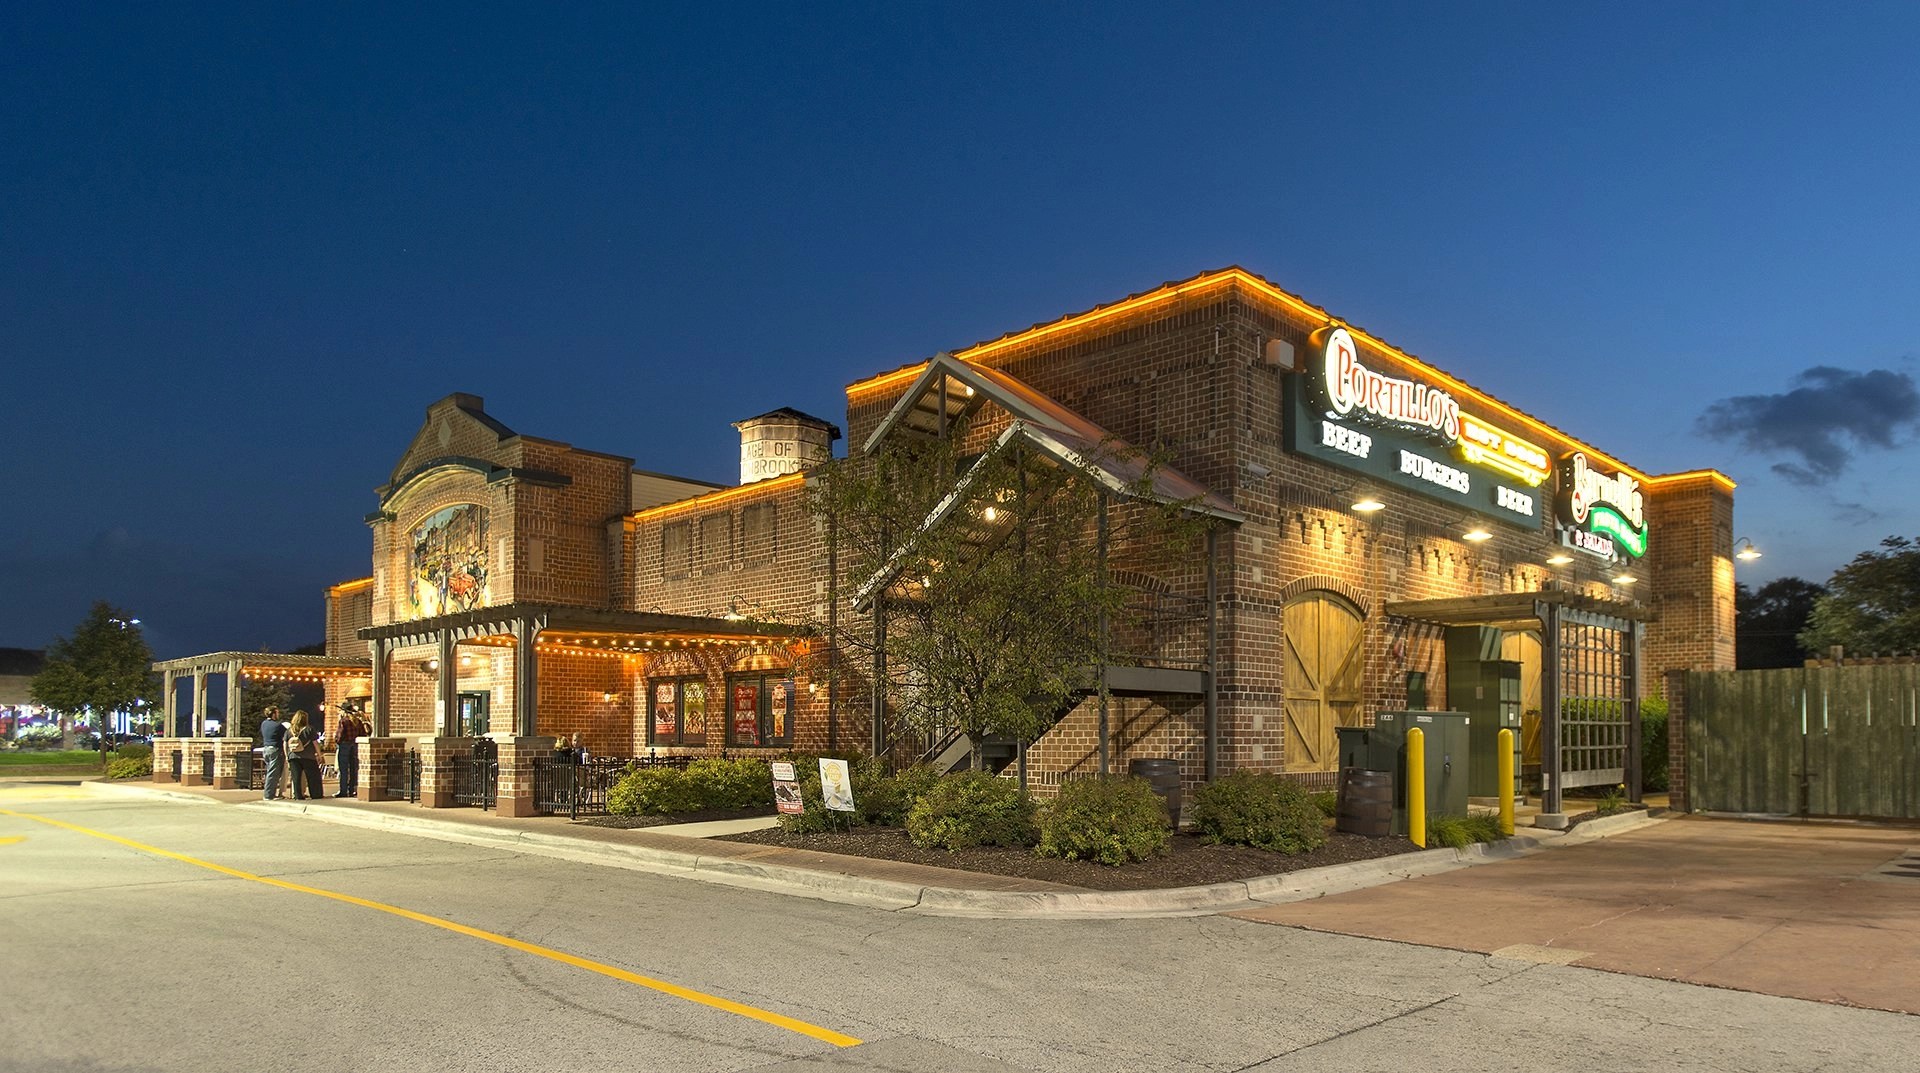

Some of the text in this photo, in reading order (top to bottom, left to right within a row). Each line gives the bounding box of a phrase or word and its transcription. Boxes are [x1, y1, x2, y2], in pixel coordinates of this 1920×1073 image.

[1326, 329, 1460, 440] PORTILLO'S
[774, 442, 793, 456] OF
[1322, 420, 1372, 458] BEEF
[743, 459, 799, 477] BROOK
[1400, 449, 1470, 494] BURGERS
[1497, 485, 1533, 516] BEER
